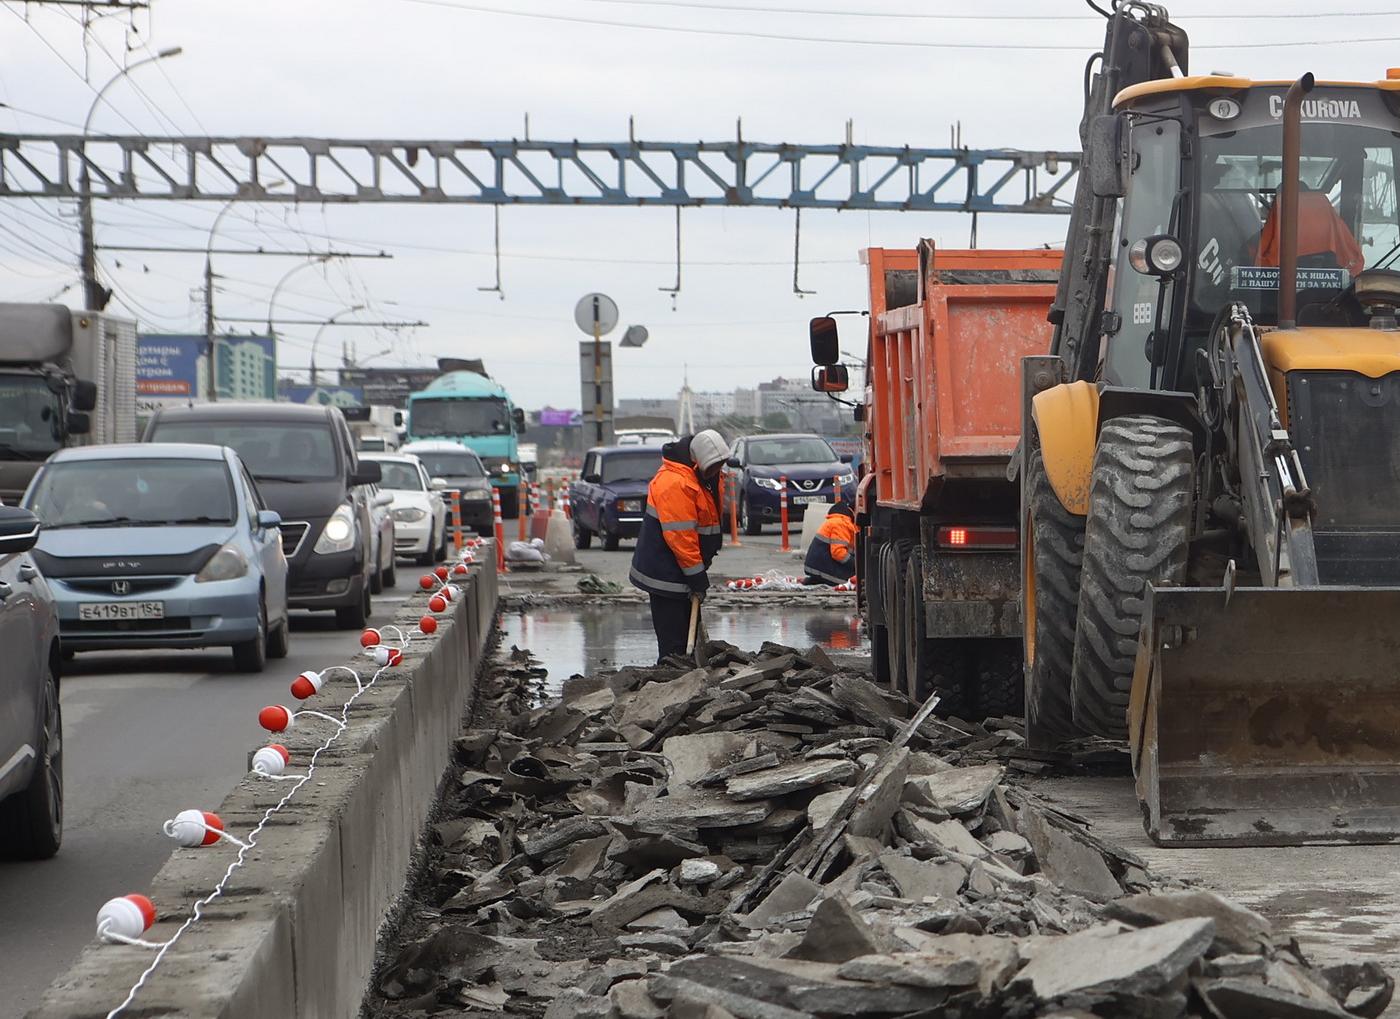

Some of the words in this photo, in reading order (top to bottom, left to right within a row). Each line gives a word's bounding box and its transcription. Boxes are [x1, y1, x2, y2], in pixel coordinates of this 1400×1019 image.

[1241, 270, 1253, 278] НА
[1255, 271, 1280, 279] РАБО
[1296, 272, 1308, 280] АК
[1310, 272, 1339, 280] ИШАК,
[1249, 280, 1275, 288] ПАШУ
[1308, 281, 1319, 289] ЗА
[141, 603, 162, 613] 154
